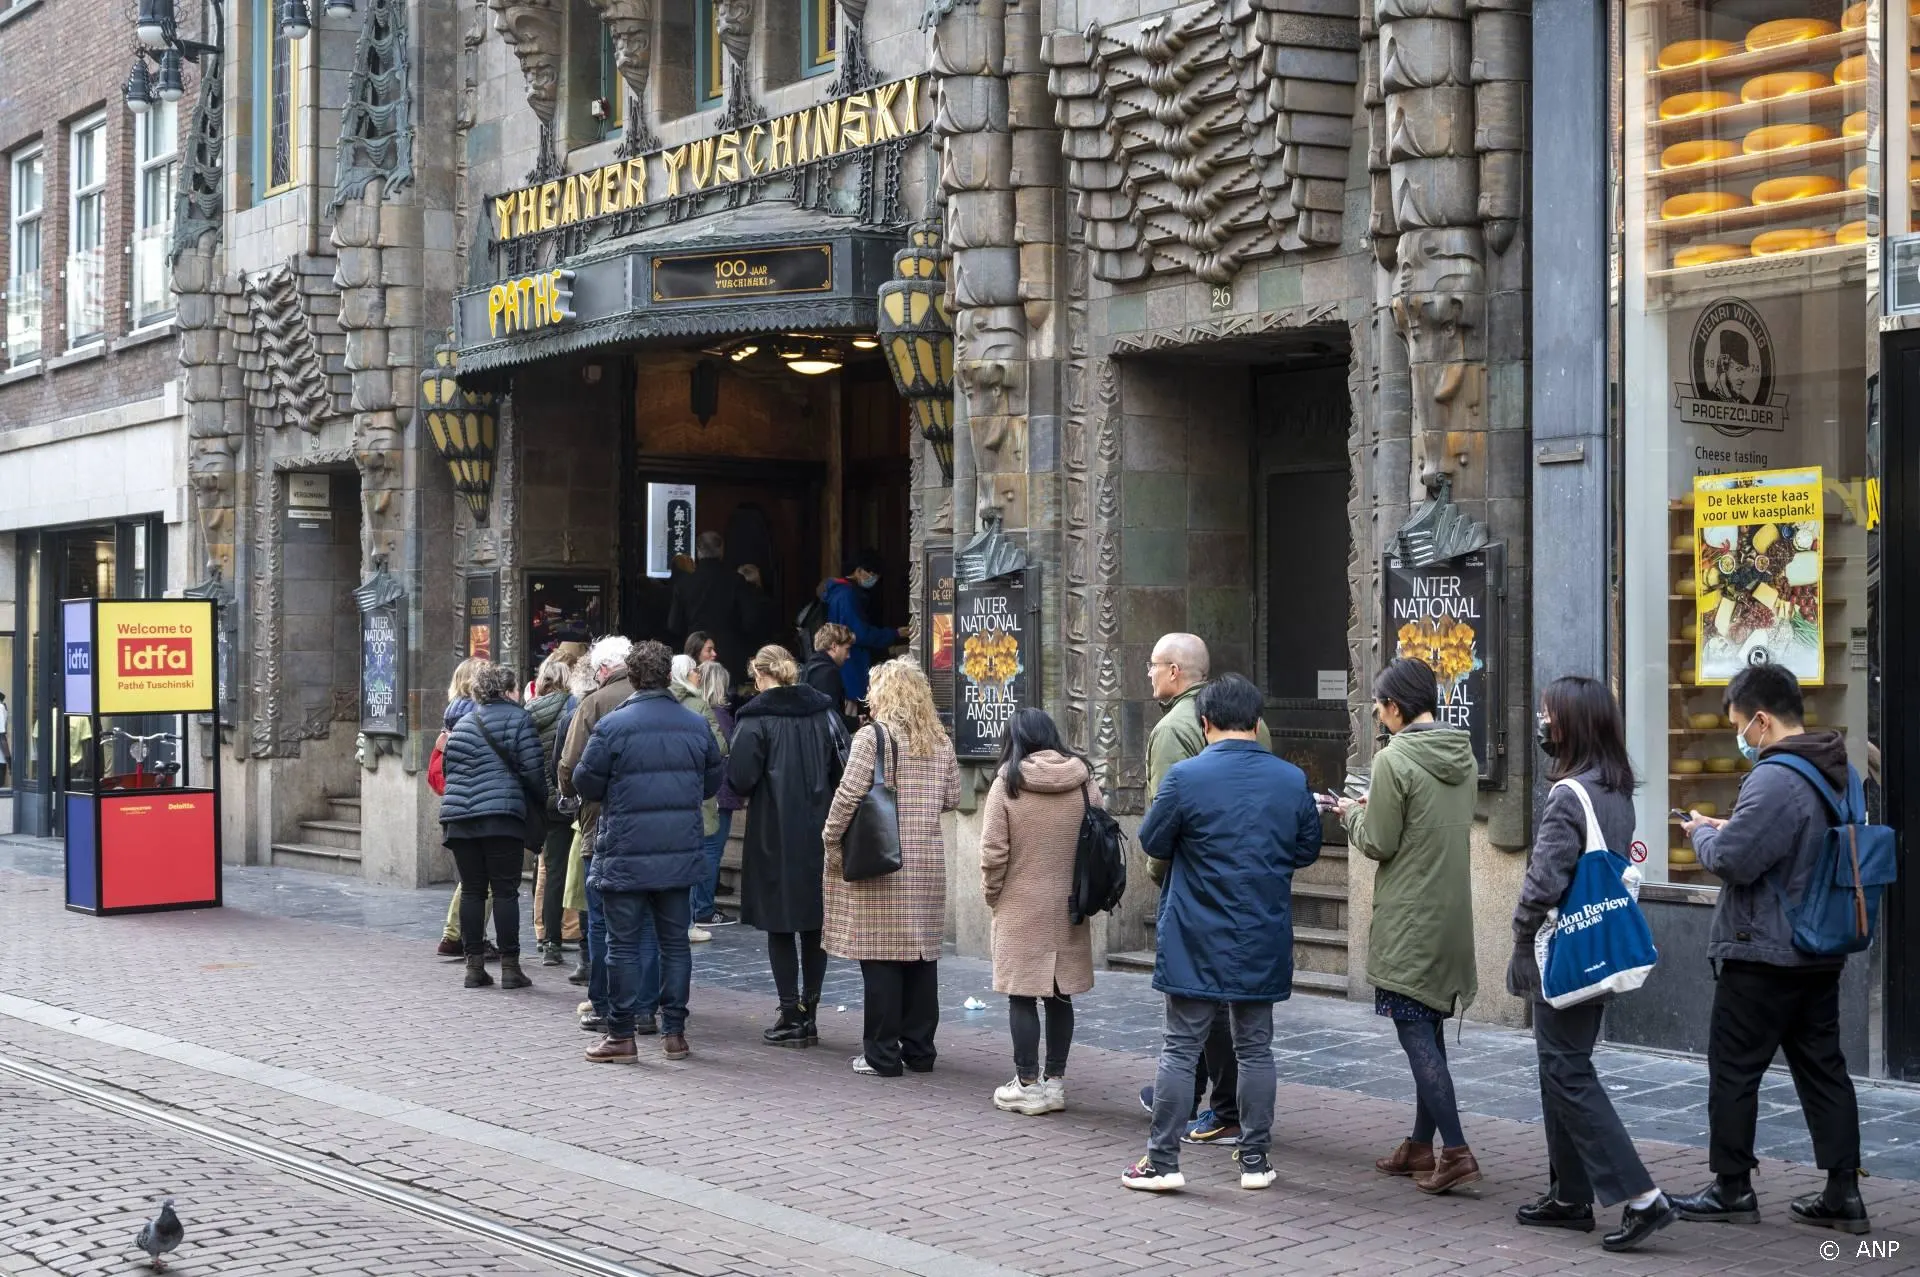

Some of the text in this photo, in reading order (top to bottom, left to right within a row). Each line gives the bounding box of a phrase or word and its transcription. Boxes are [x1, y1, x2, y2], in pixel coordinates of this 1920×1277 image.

[662, 75, 920, 197] TUSCHINSKI
[715, 259, 768, 278] 100 JAAR
[715, 276, 768, 289] TUSCHINSKI
[1212, 285, 1231, 308] 26
[1699, 305, 1767, 349] HENRI WILLIG
[1692, 403, 1774, 425] PROEFZOLDER
[1695, 446, 1768, 468] Cheese tasting
[1708, 490, 1809, 507] De lekkerste kaas
[1703, 503, 1815, 522] voor uw kaasplank!
[1412, 575, 1461, 597] INTER
[973, 596, 1007, 615] INTER
[1393, 597, 1480, 619] NATIONAL
[117, 623, 192, 635] Welcome to
[370, 616, 389, 629] INTER
[961, 614, 1022, 633] NATIONAL
[364, 628, 395, 642] NATIONAL
[68, 648, 89, 670] idfa
[124, 644, 186, 671] idfa
[118, 679, 194, 690] Pathé Tuschinski
[367, 692, 392, 705] AMSTER
[371, 704, 387, 718] DAM
[966, 703, 1015, 721] AMSTER
[977, 720, 1005, 738] DAM
[1583, 897, 1629, 919] Review
[1564, 924, 1576, 935] OF
